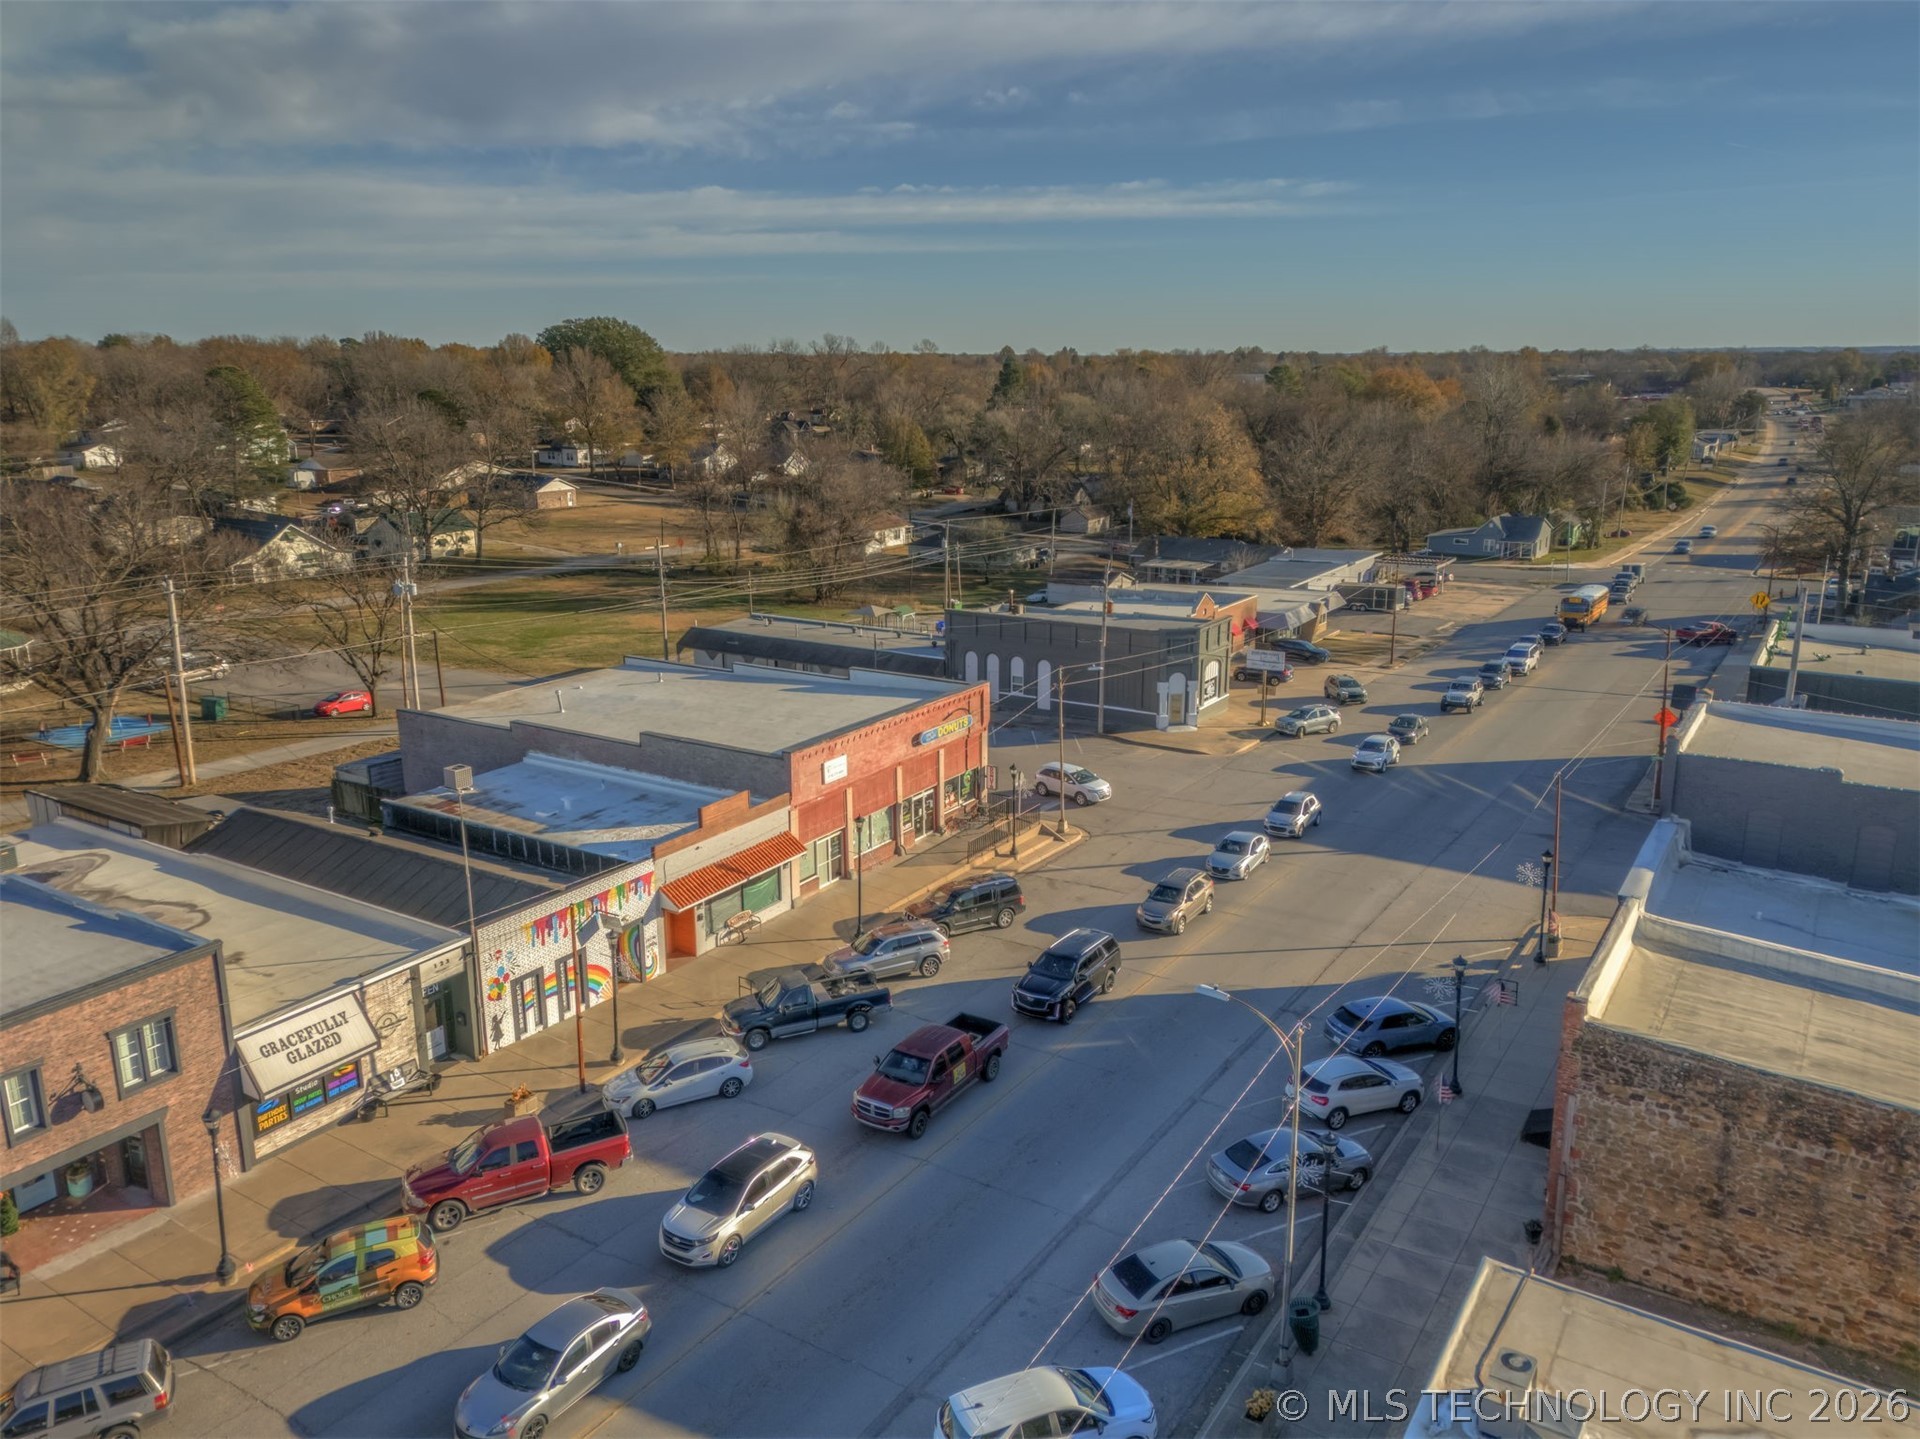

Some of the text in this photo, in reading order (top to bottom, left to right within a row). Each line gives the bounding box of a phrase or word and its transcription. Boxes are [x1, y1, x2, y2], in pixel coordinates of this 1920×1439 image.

[937, 717, 969, 738] DONUTS
[433, 958, 450, 969] 123
[259, 1010, 349, 1058] GRACEFULLY
[286, 1032, 342, 1064] GLAZED
[295, 1080, 318, 1094] Studio
[258, 1111, 288, 1131] PARTIES
